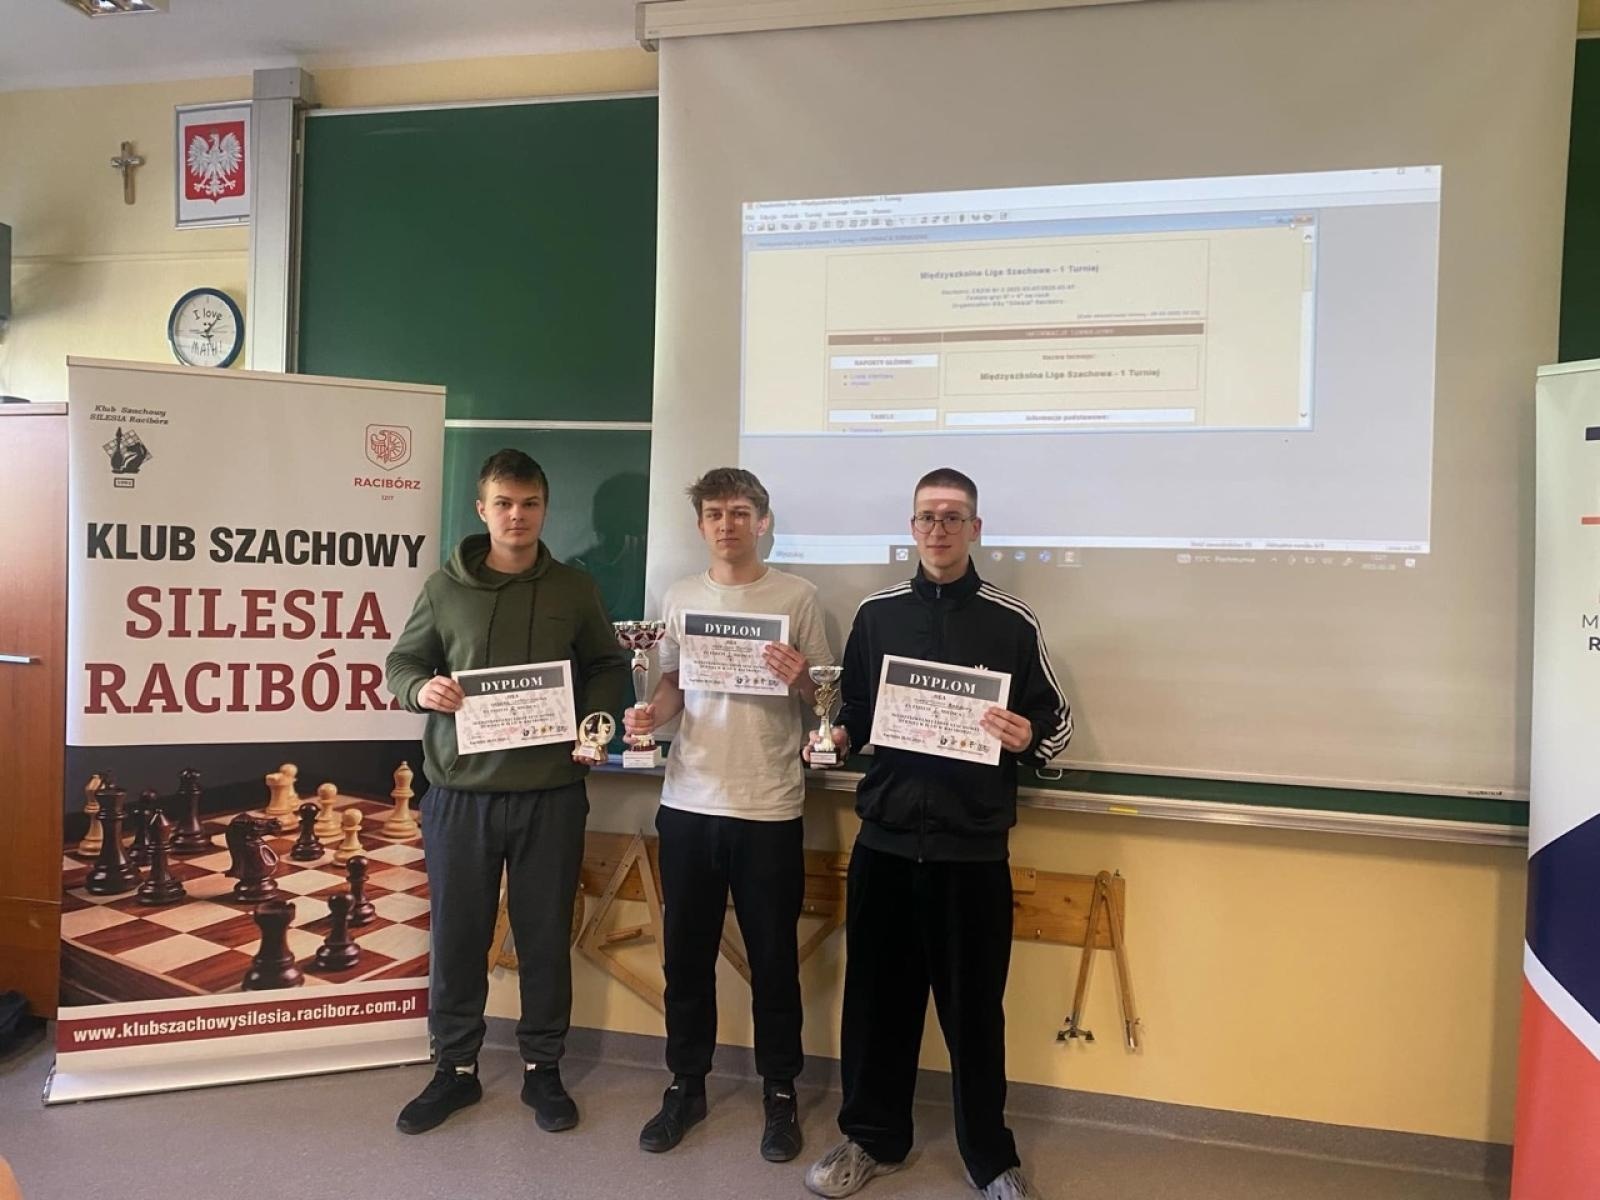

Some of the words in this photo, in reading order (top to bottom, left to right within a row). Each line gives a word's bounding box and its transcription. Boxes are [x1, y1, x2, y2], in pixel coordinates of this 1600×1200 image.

[1069, 264, 1099, 274] Turniej
[192, 309, 200, 320] I
[203, 307, 222, 320] love
[1129, 369, 1160, 378] Turniej
[94, 404, 117, 412] Klub
[121, 407, 166, 417] Szachowy
[90, 413, 126, 422] SILESIA
[129, 416, 168, 424] Racibórz
[354, 476, 421, 490] RACIBÓRZ
[87, 522, 196, 562] KLUB
[209, 526, 426, 568] SZACHOWY
[126, 585, 391, 640] SILESIA
[704, 623, 761, 637] DYPLOM
[84, 648, 406, 714] RACIBÓR
[480, 676, 543, 692] DYPLOM
[909, 673, 976, 694] DYPLOM
[74, 996, 416, 1042] www.klubszachowysilesia.raciborz.com.pl
